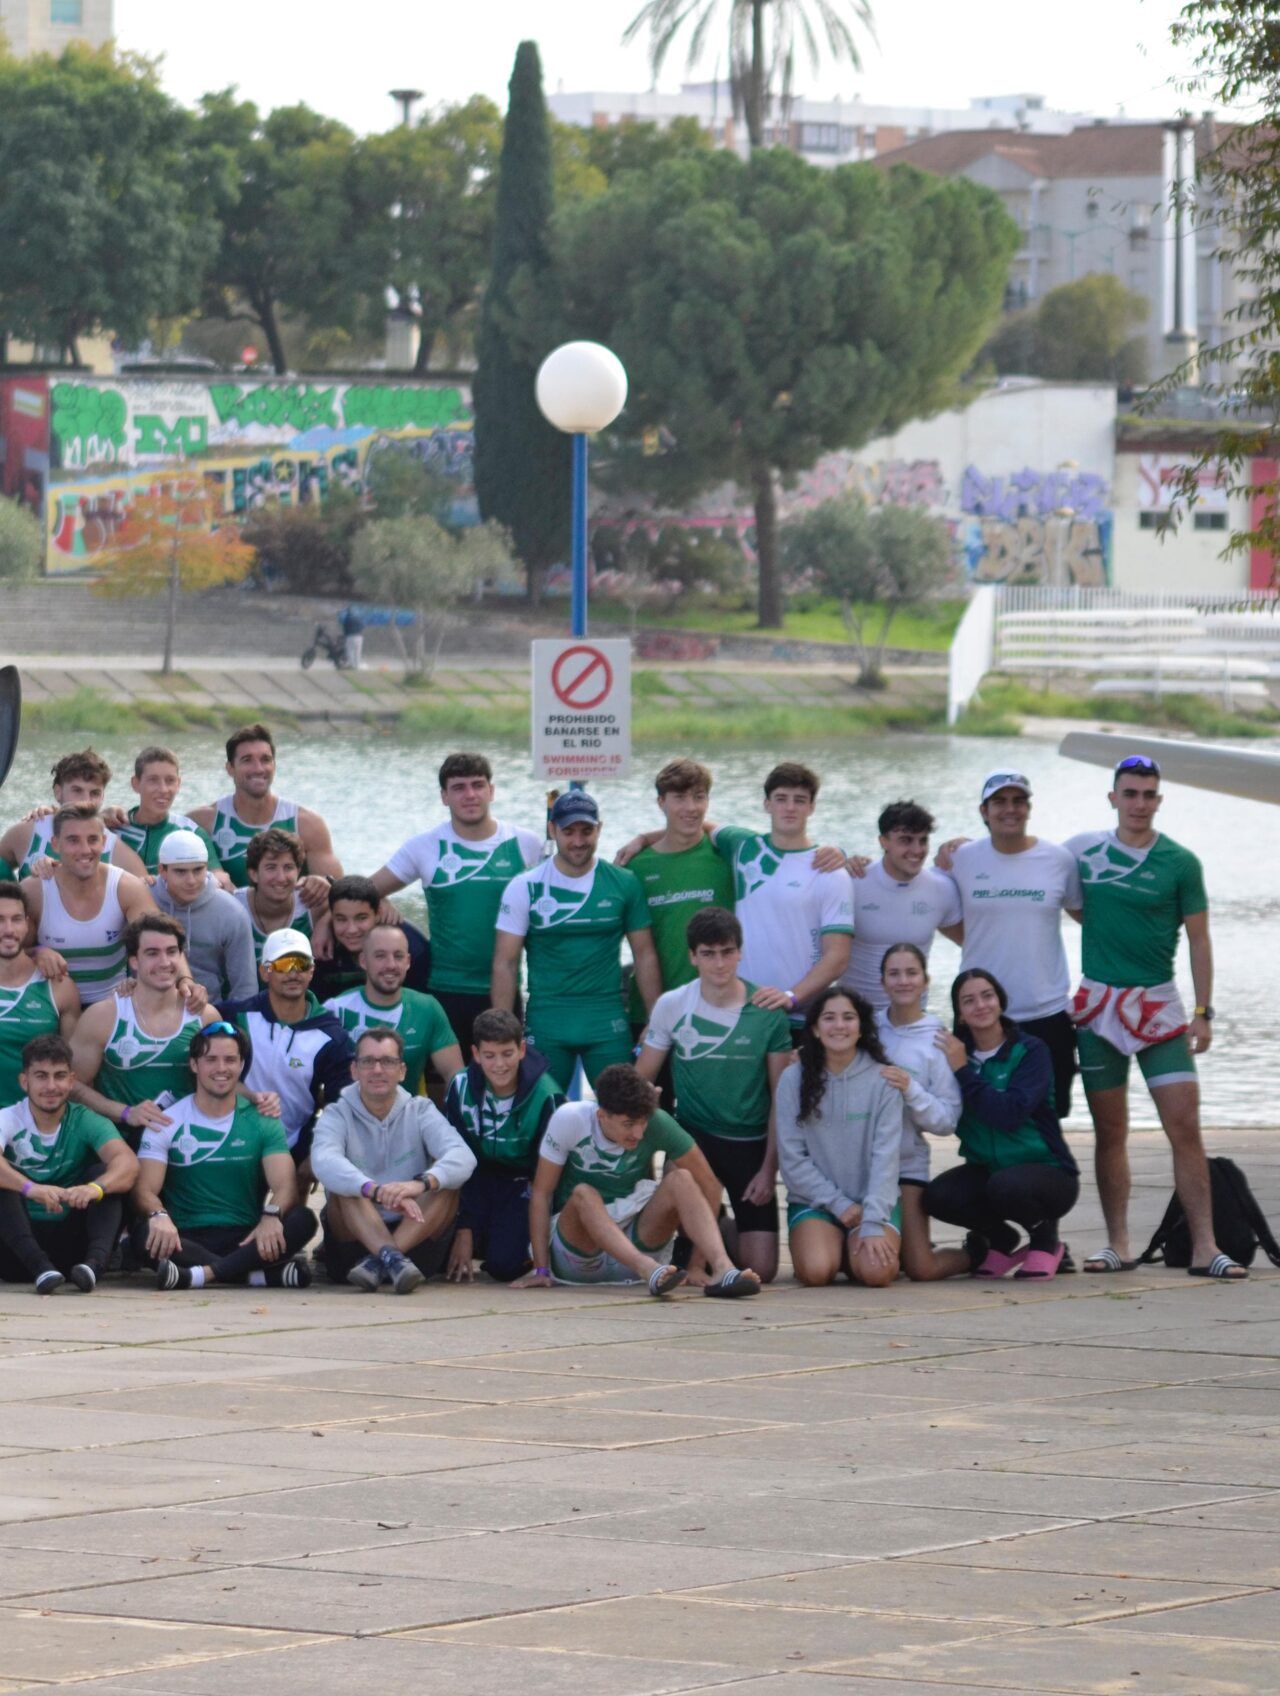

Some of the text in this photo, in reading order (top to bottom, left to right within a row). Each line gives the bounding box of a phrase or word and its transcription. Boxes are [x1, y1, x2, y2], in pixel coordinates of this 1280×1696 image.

[548, 714, 617, 724] PROHIBIDO
[604, 727, 620, 736] EN
[563, 739, 577, 748] EL
[543, 754, 623, 764] SWIMMING IS
